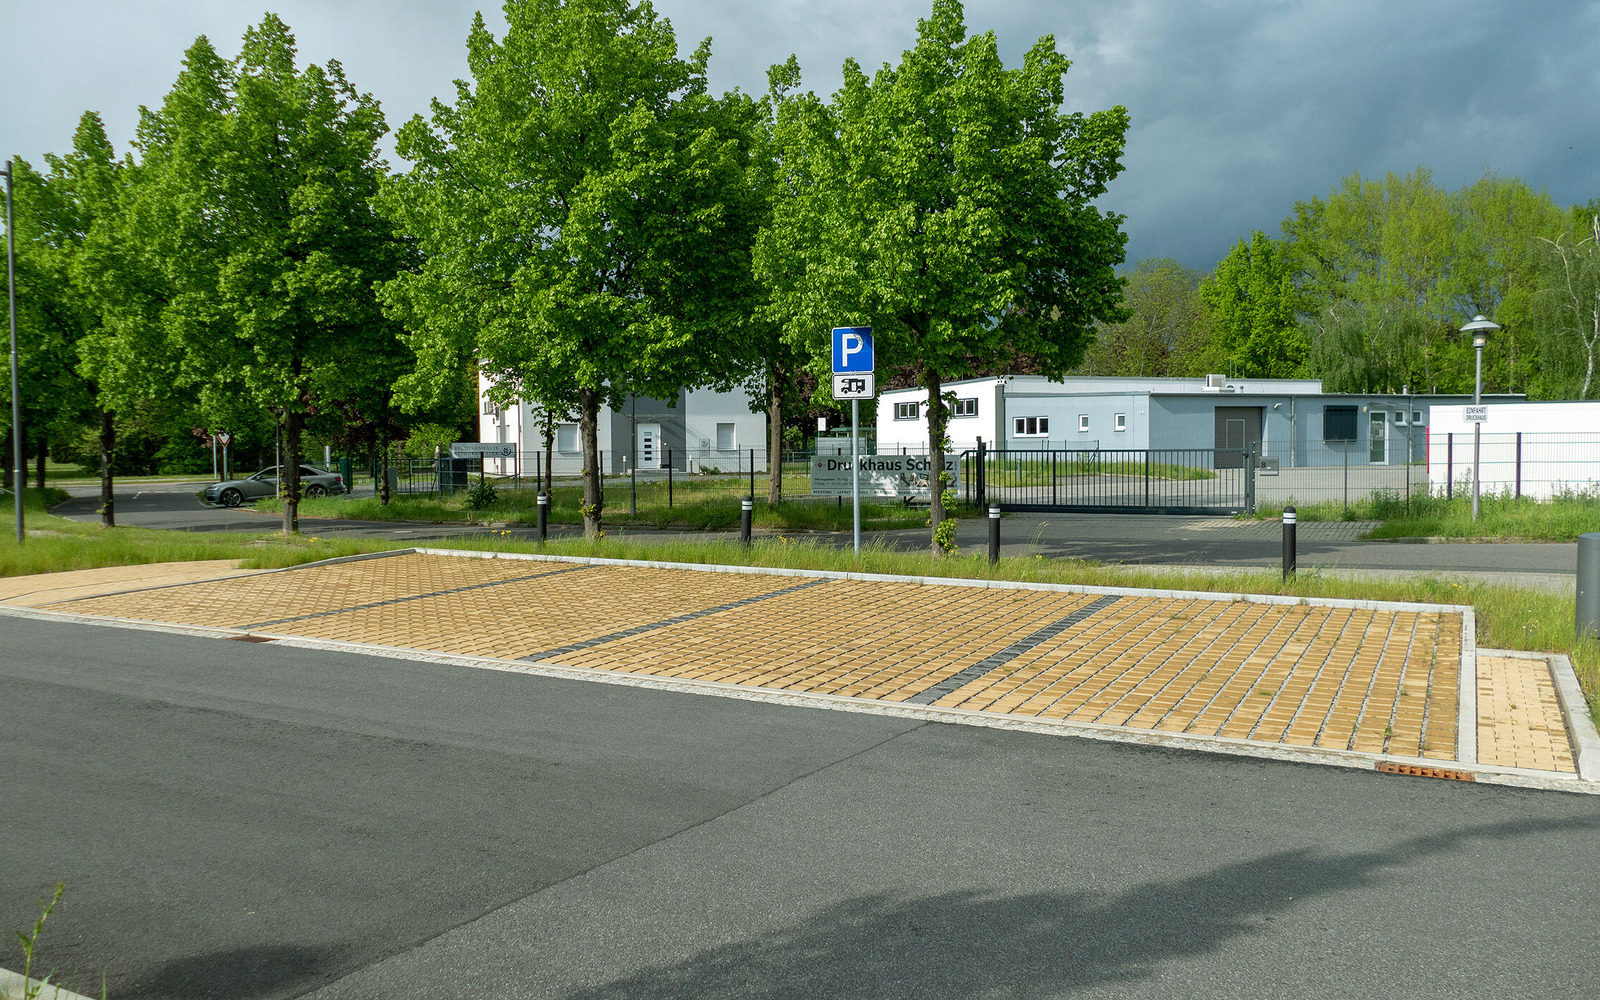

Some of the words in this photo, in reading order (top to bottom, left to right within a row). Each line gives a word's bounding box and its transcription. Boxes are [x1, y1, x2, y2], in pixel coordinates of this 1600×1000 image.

[842, 333, 863, 367] P
[828, 458, 902, 471] Drukhaus
[906, 458, 953, 471] Schz
